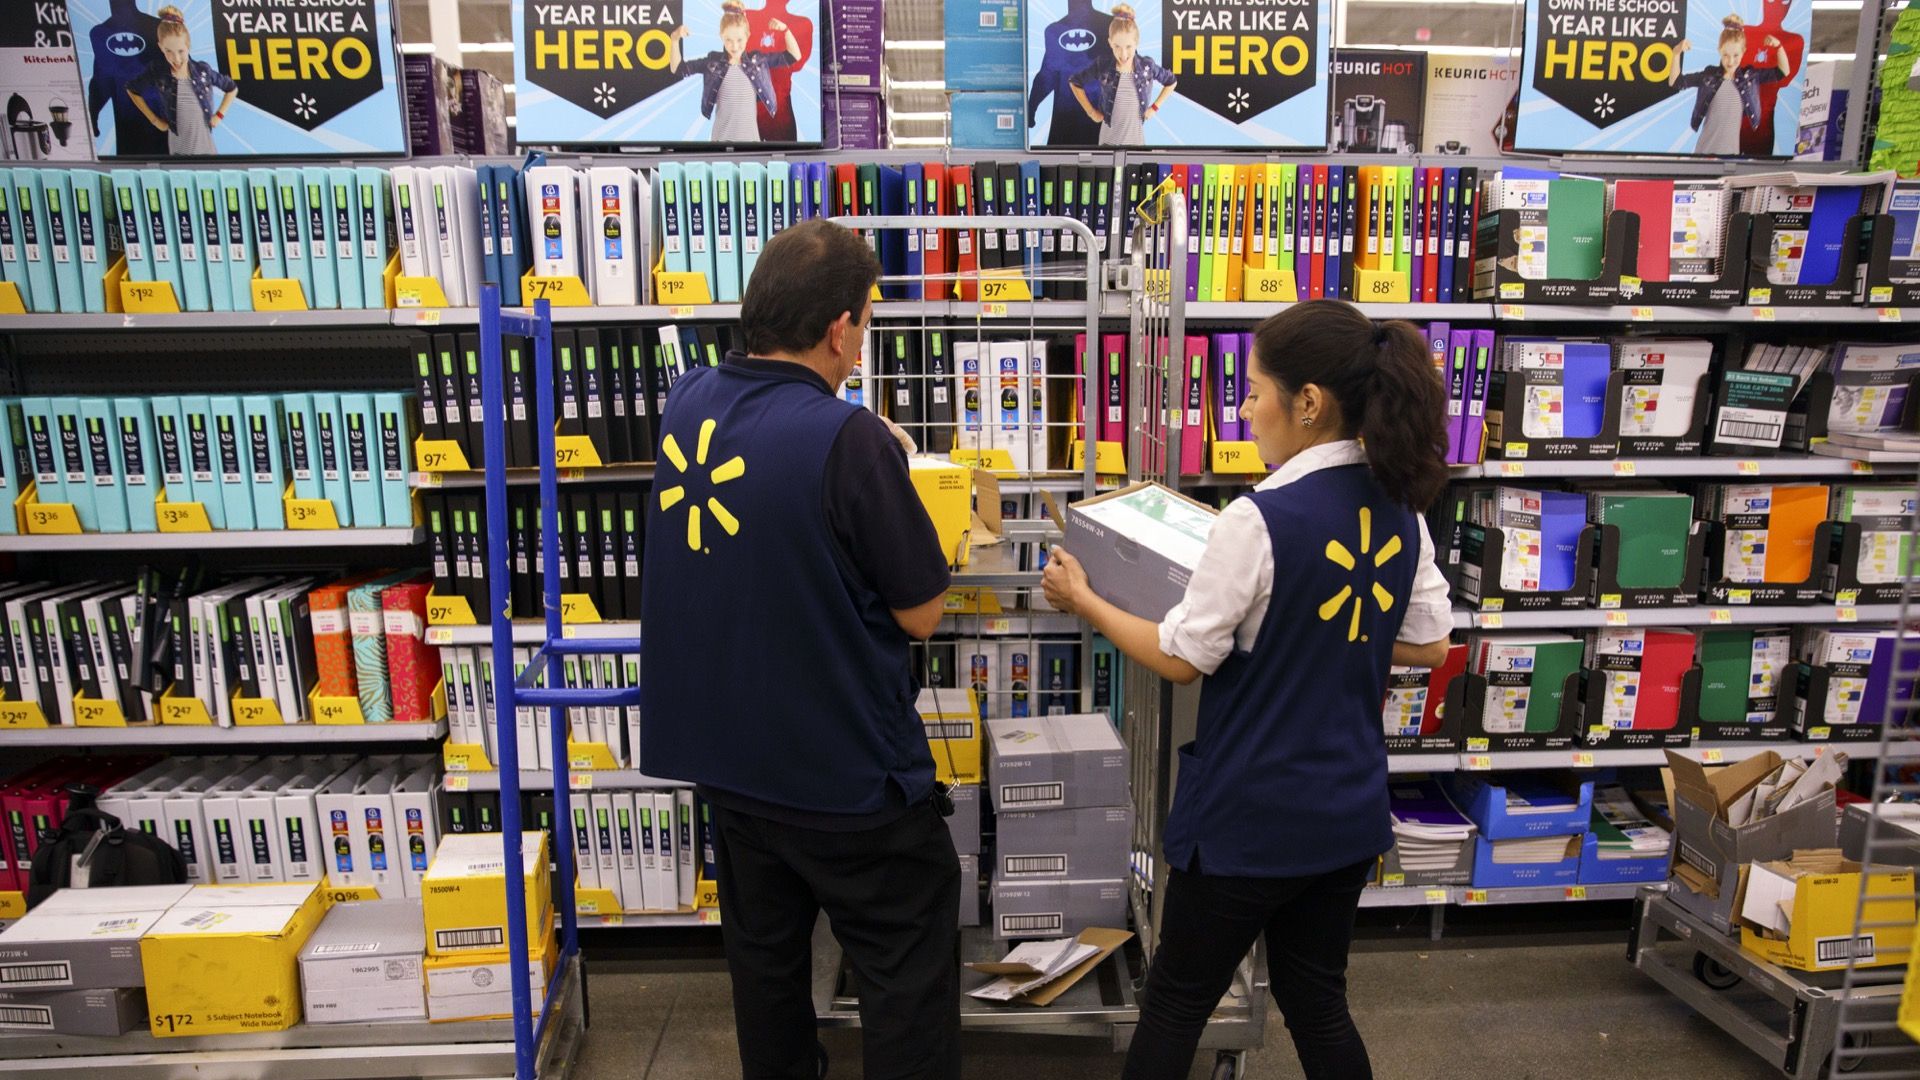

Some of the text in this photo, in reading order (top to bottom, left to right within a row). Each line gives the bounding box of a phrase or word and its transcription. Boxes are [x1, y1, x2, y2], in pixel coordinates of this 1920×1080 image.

[1548, 0, 1679, 14] OWN THE SCHOOL
[534, 5, 674, 25] YEAR LIKE A
[1172, 11, 1310, 31] YEAR LIKE A
[223, 11, 368, 33] YEAR LIKE A
[1548, 14, 1678, 38] YEAR LIKE A
[34, 30, 50, 48] &
[535, 29, 672, 70] HERO
[1172, 35, 1309, 76] HERO
[226, 37, 372, 80] HERO
[1544, 39, 1673, 83] HERO
[1383, 63, 1414, 75] HOT
[1435, 67, 1487, 80] KEURIG
[1787, 196, 1792, 210] 5
[662, 281, 684, 294] $192
[984, 283, 1007, 296] 97¢
[130, 288, 153, 302] $192
[260, 289, 283, 302] $192
[1539, 352, 1545, 367] 5
[1640, 353, 1646, 367] 5
[424, 454, 447, 467] 97¢
[556, 449, 579, 463] 97¢
[1219, 451, 1240, 463] $192
[1744, 500, 1750, 512] 5
[33, 512, 58, 525] $336
[164, 511, 189, 523] $336
[293, 507, 317, 520] $336
[430, 607, 452, 620] 97¢
[2, 711, 27, 724] $247
[79, 708, 104, 719] $247
[167, 706, 191, 718] $247
[239, 707, 264, 719] $247
[320, 706, 342, 719] $444
[213, 1013, 242, 1021] Subject
[244, 1011, 282, 1019] Notebook
[155, 1014, 193, 1032] $172
[261, 1019, 283, 1027] Ruled
